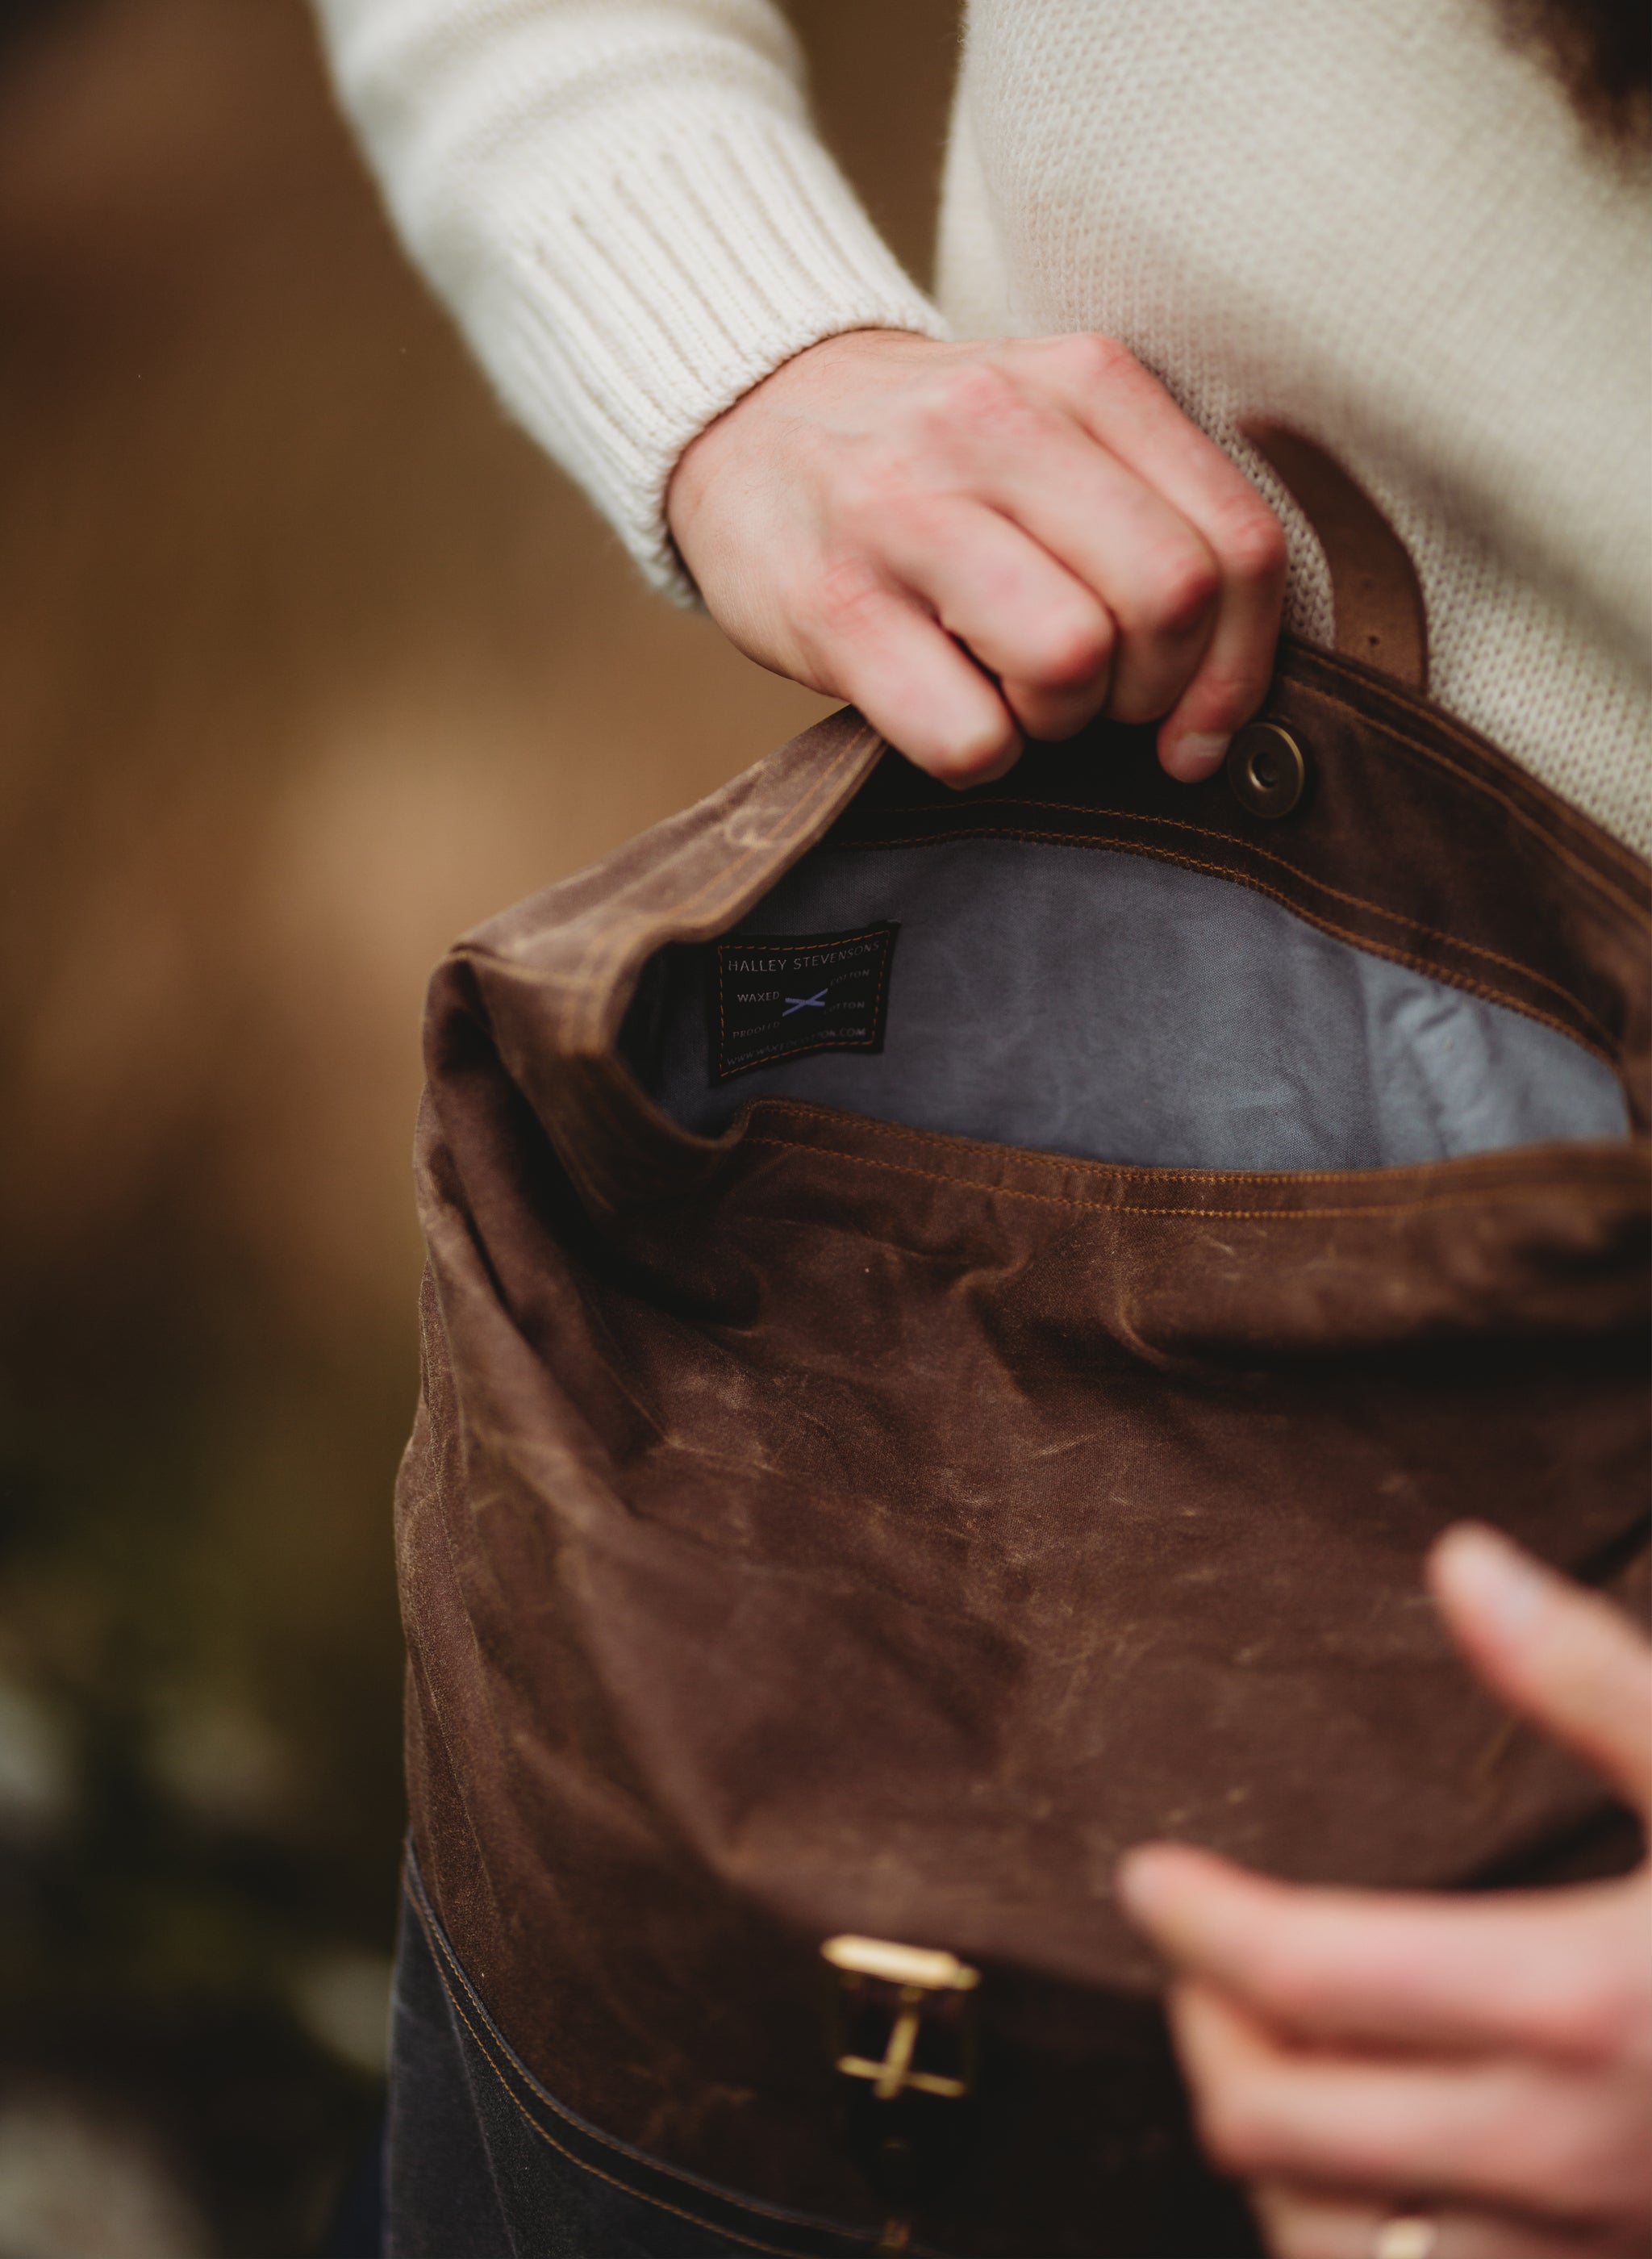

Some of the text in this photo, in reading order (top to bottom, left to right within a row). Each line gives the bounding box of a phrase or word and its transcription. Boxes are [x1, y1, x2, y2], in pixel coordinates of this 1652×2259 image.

[728, 941, 879, 971] HALLEY STEVENSONS
[737, 992, 779, 1003] WAXED
